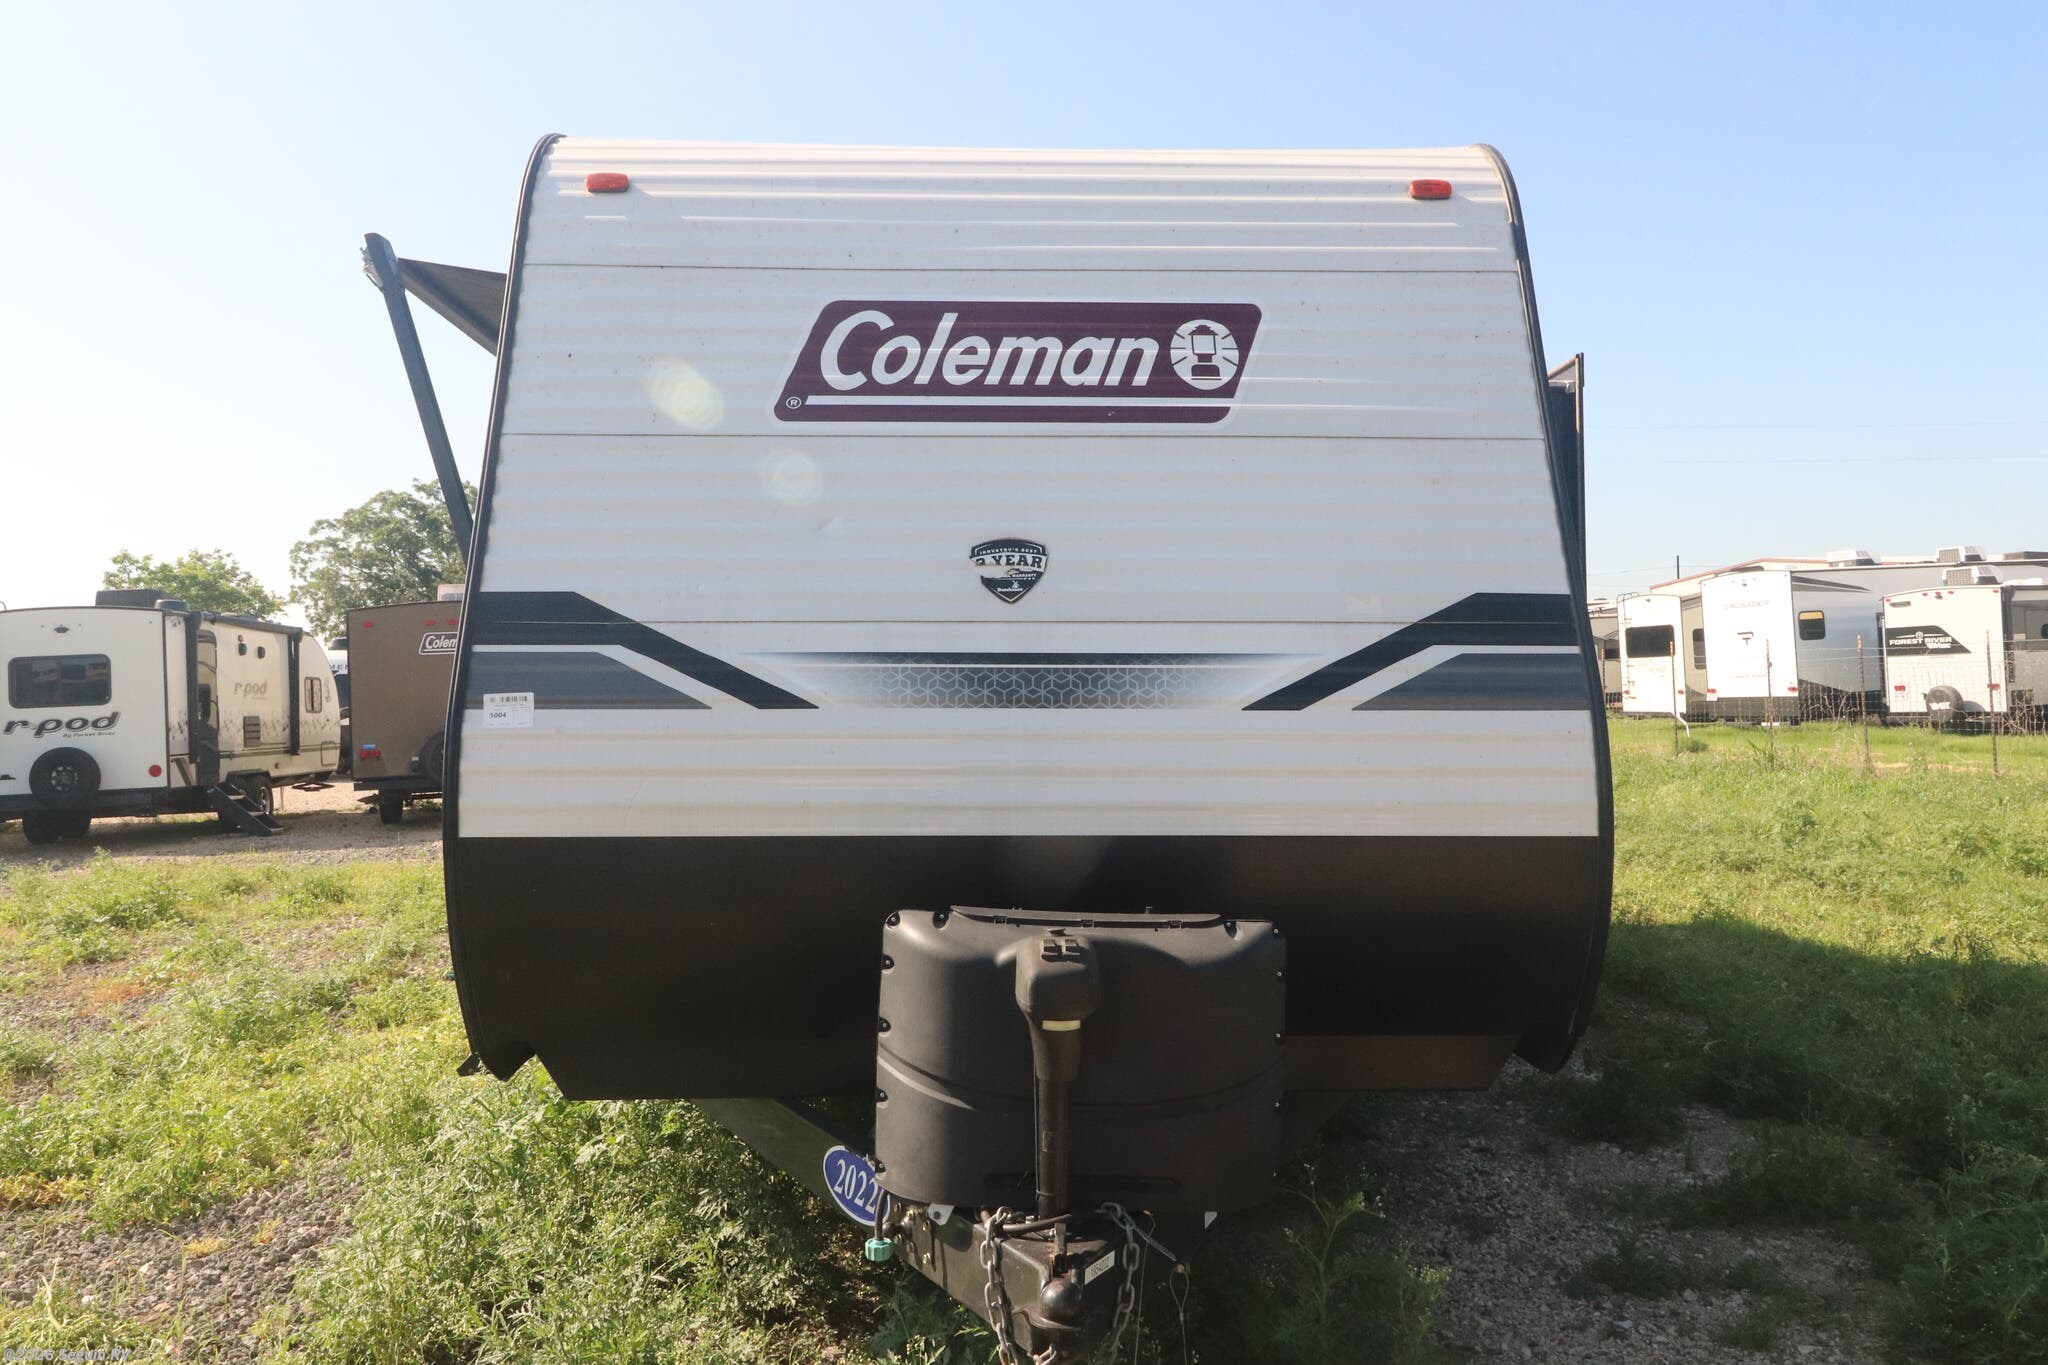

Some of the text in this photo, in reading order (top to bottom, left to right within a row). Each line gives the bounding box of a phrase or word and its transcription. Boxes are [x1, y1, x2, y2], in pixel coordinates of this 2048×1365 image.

[820, 309, 1159, 391] Coleman
[992, 555, 1042, 568] YEAR
[1889, 638, 1923, 646] FOREST
[833, 1159, 878, 1214] 2022
